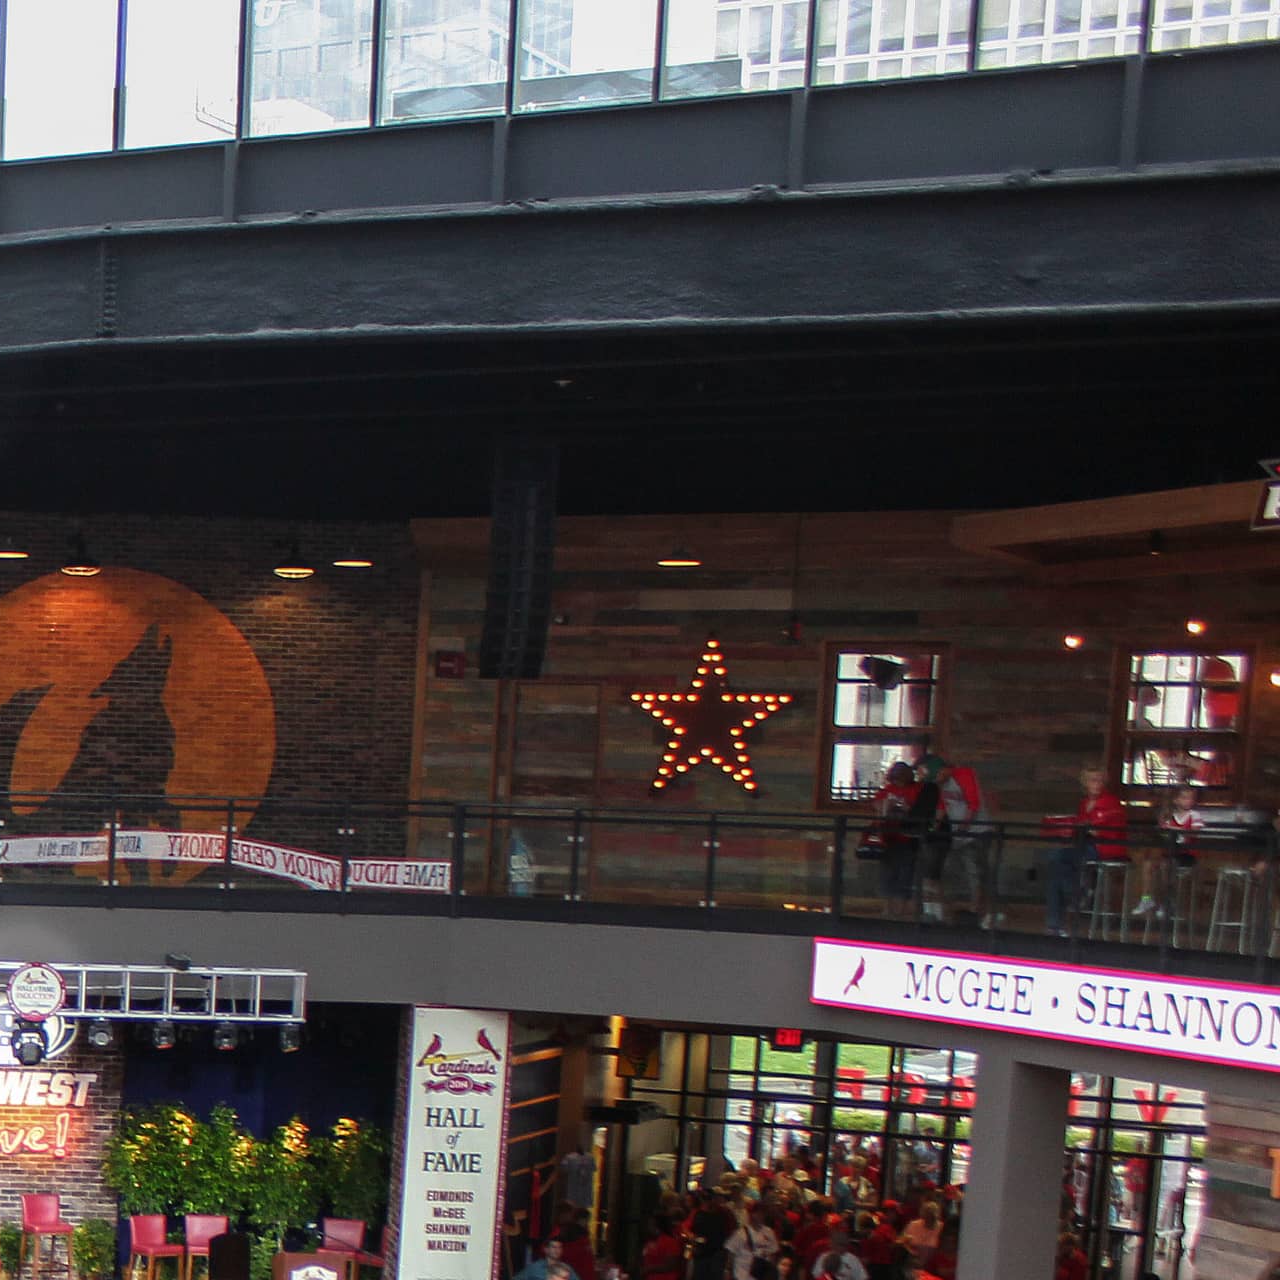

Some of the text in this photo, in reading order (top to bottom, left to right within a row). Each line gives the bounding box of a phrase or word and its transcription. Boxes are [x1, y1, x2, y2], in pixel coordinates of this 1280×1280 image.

[904, 961, 1035, 1016] MCGEE
[431, 1055, 497, 1076] Cardinals
[425, 1107, 485, 1128] HALL
[447, 1131, 463, 1149] of
[423, 1152, 482, 1173] FAME
[427, 1190, 474, 1202] EDMONDS
[433, 1207, 466, 1219] McGEE
[425, 1223, 471, 1235] SHANNON
[427, 1240, 467, 1252] MARION
